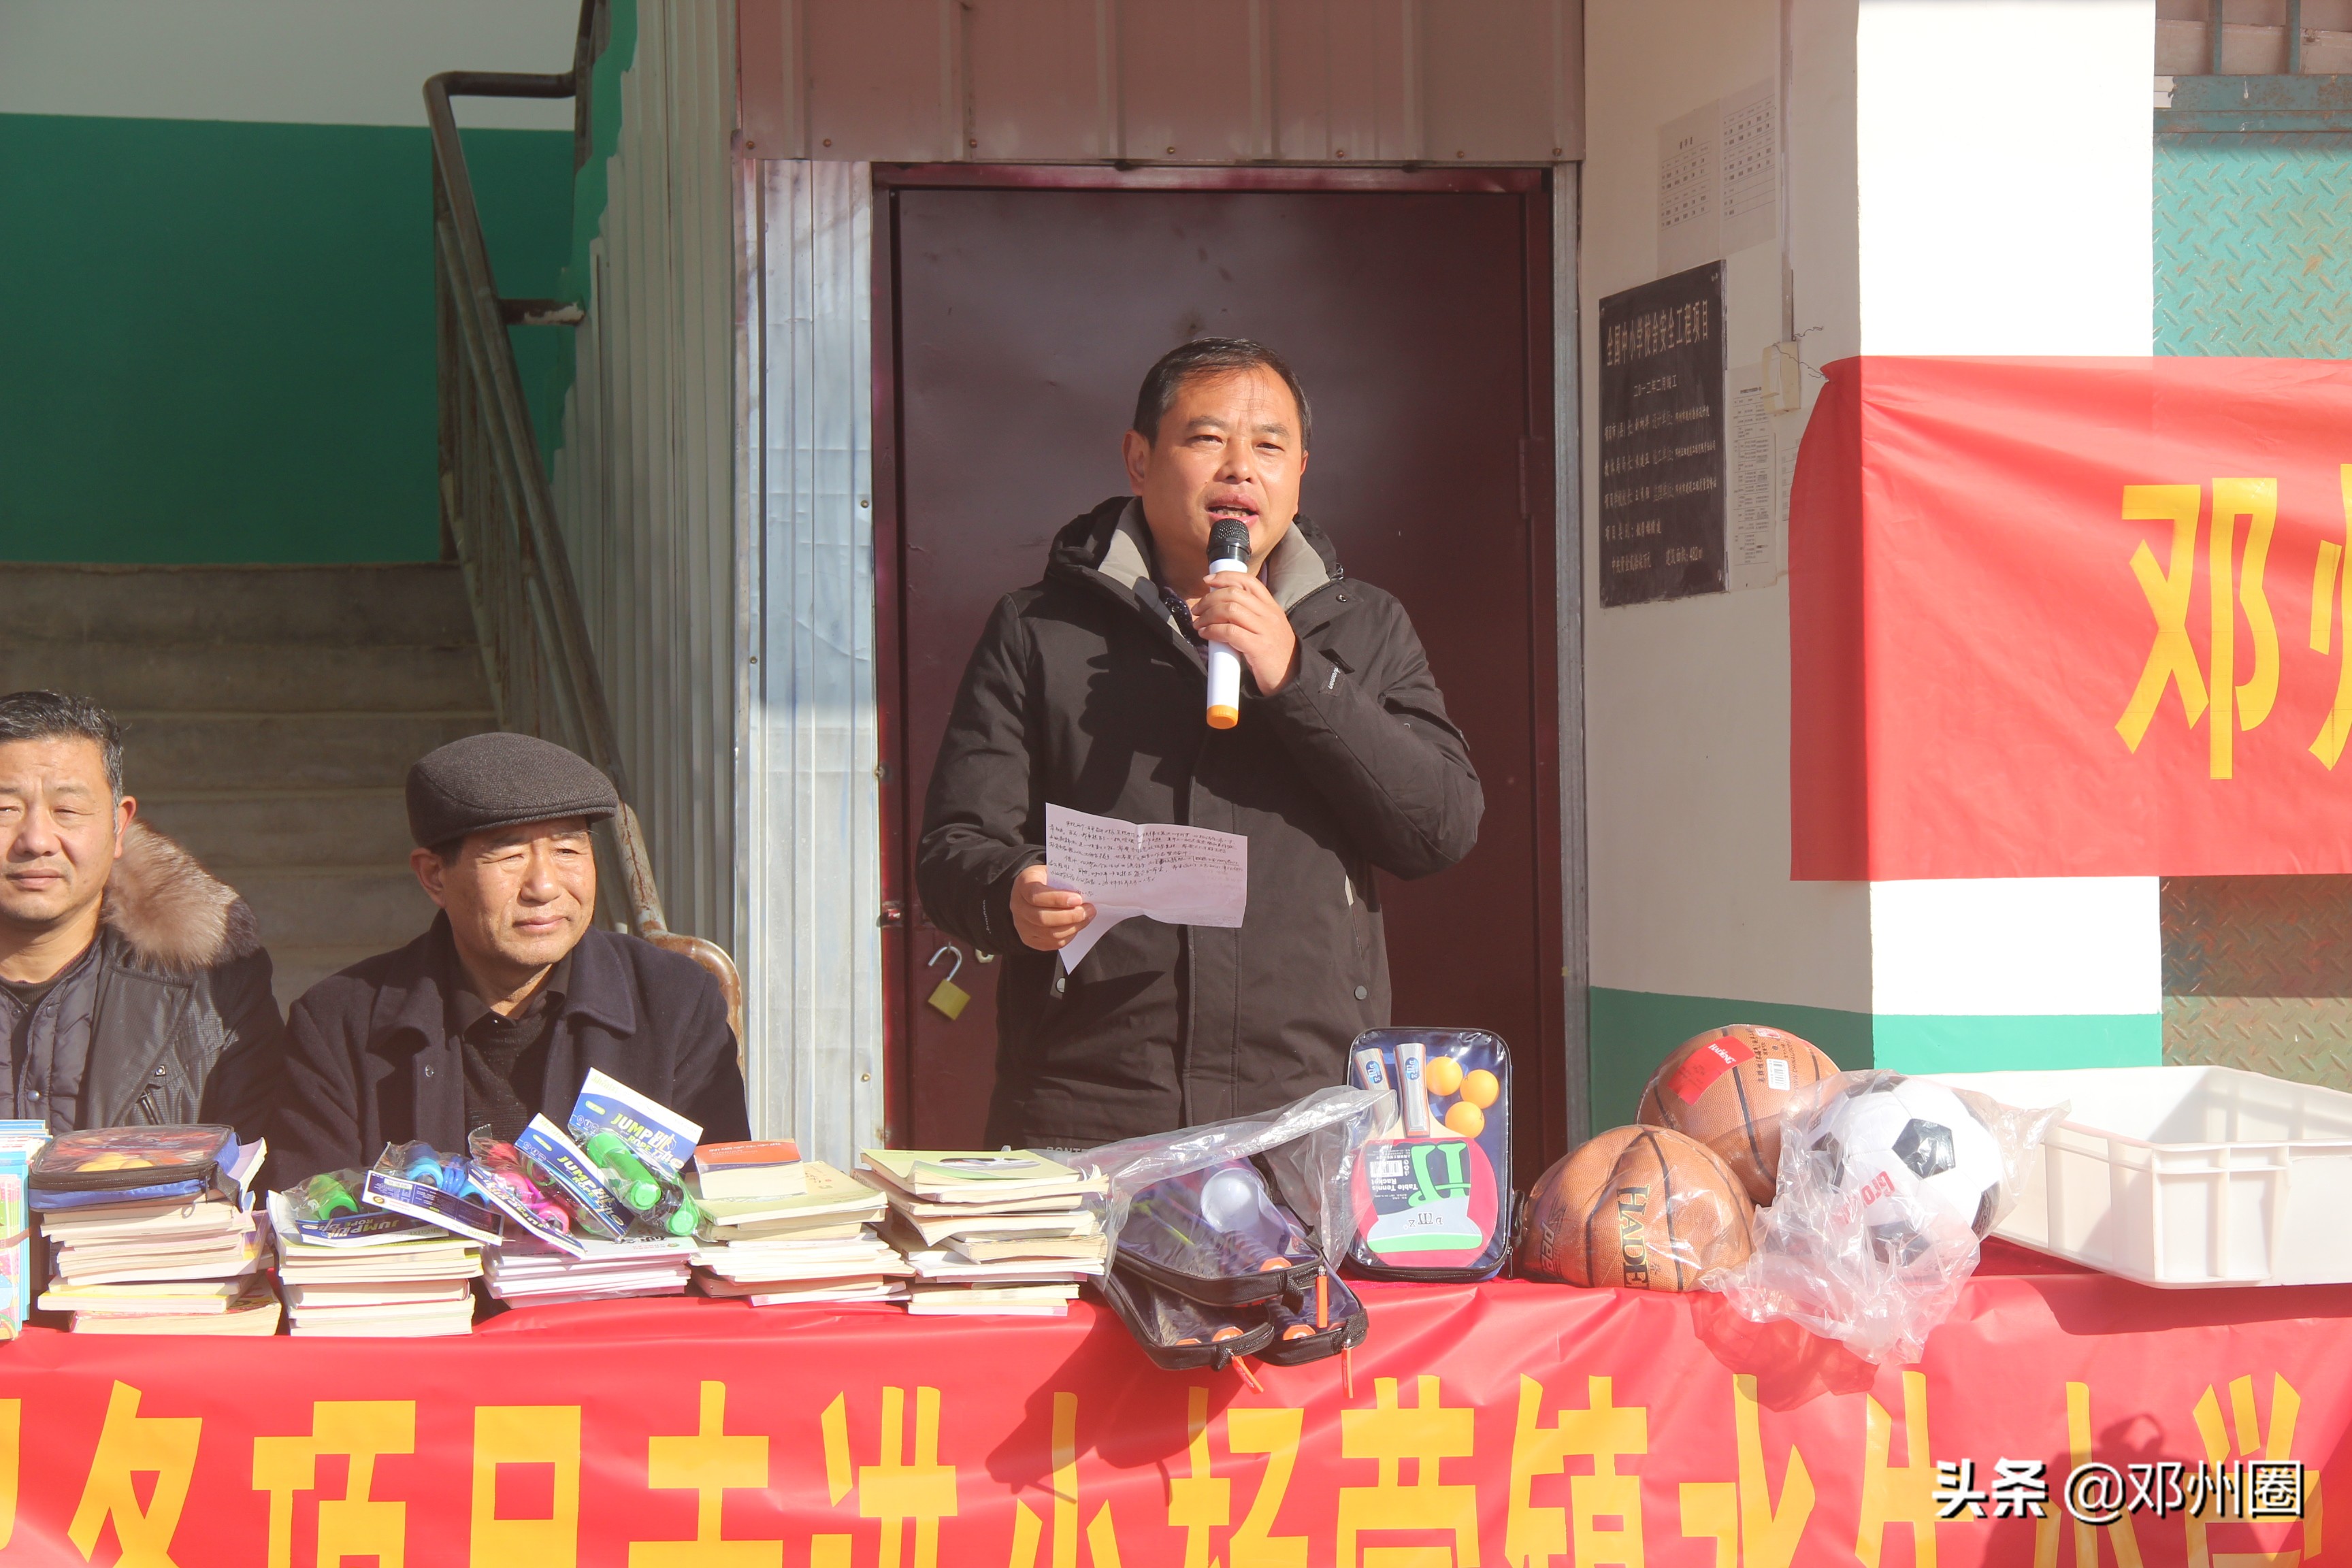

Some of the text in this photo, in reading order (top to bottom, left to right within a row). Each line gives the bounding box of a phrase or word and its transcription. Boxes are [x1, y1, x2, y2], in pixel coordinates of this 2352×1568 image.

[1607, 299, 1708, 366] 全国中小学校舍安全工程项目
[2114, 463, 2352, 780] 邓
[610, 1113, 653, 1141] JUMP
[557, 1156, 596, 1189] JUMP
[1371, 1177, 1397, 1186] Racket
[572, 1177, 595, 1198] ROPE
[1371, 1182, 1418, 1193] Table Tennis
[350, 1218, 400, 1235] JUMP
